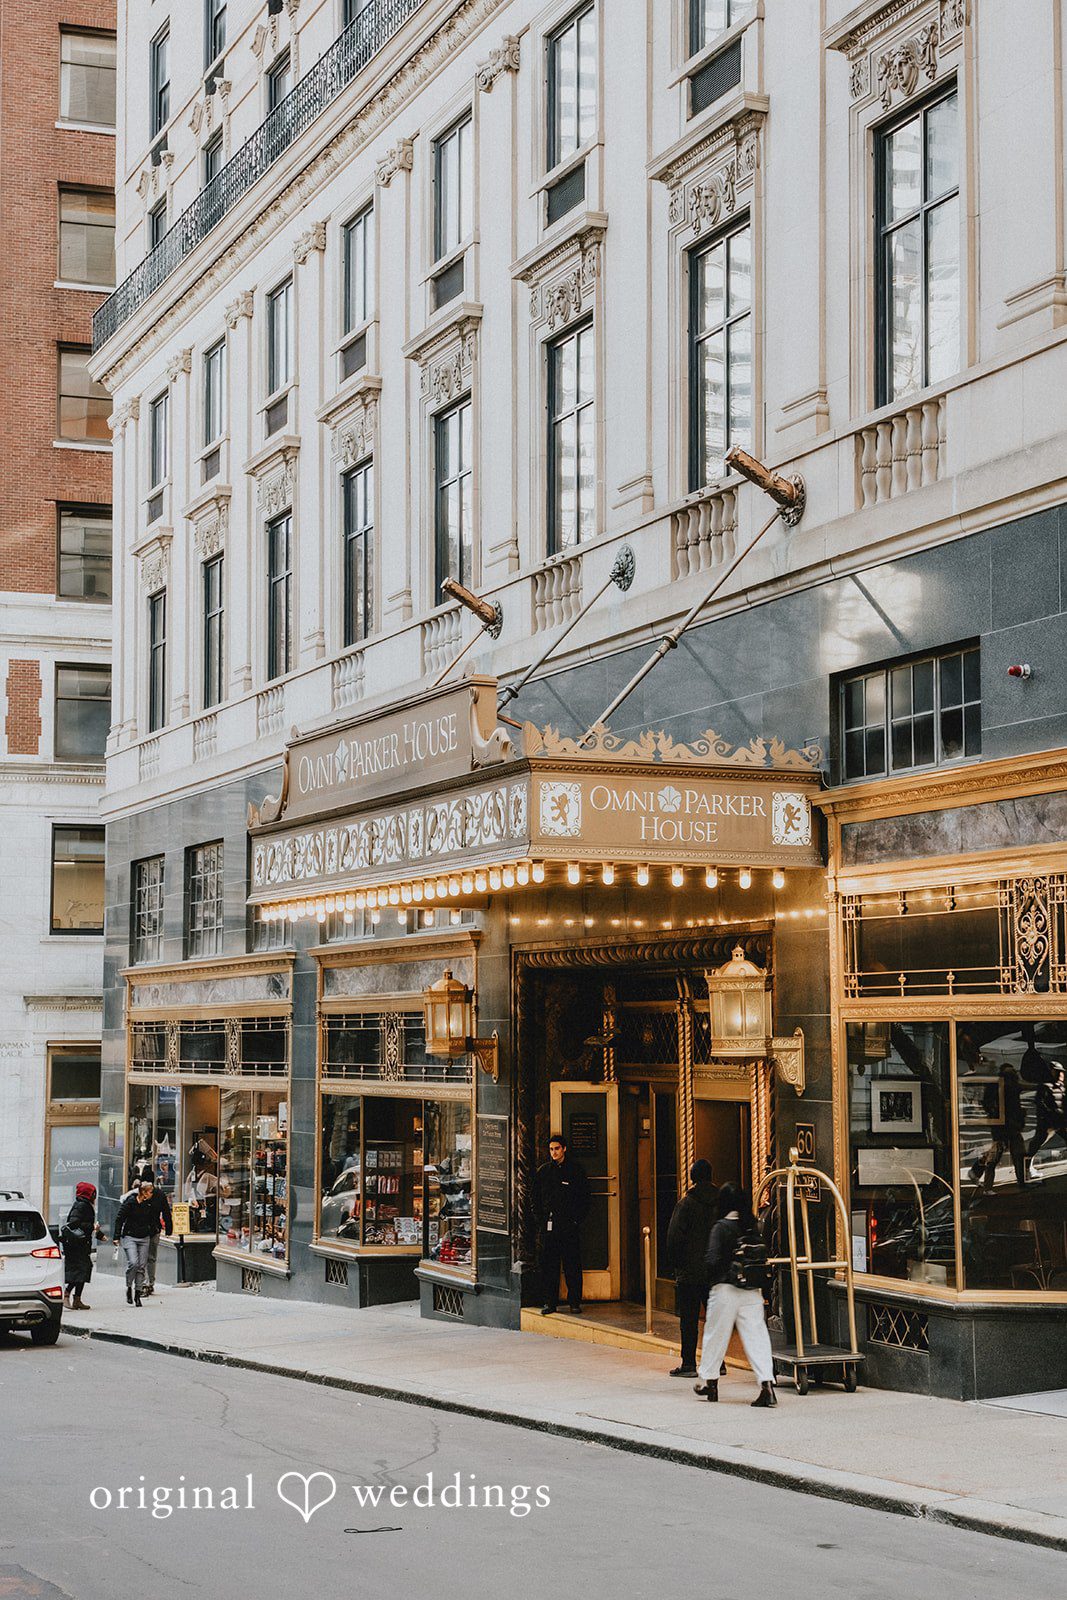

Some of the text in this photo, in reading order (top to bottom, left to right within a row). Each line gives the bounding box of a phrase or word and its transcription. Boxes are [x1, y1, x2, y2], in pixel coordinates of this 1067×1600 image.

[298, 713, 458, 794] OMNI PARKER HOUSE
[589, 785, 767, 817] OMNI PARKER
[640, 816, 719, 843] HOUSE
[797, 1130, 813, 1155] 60
